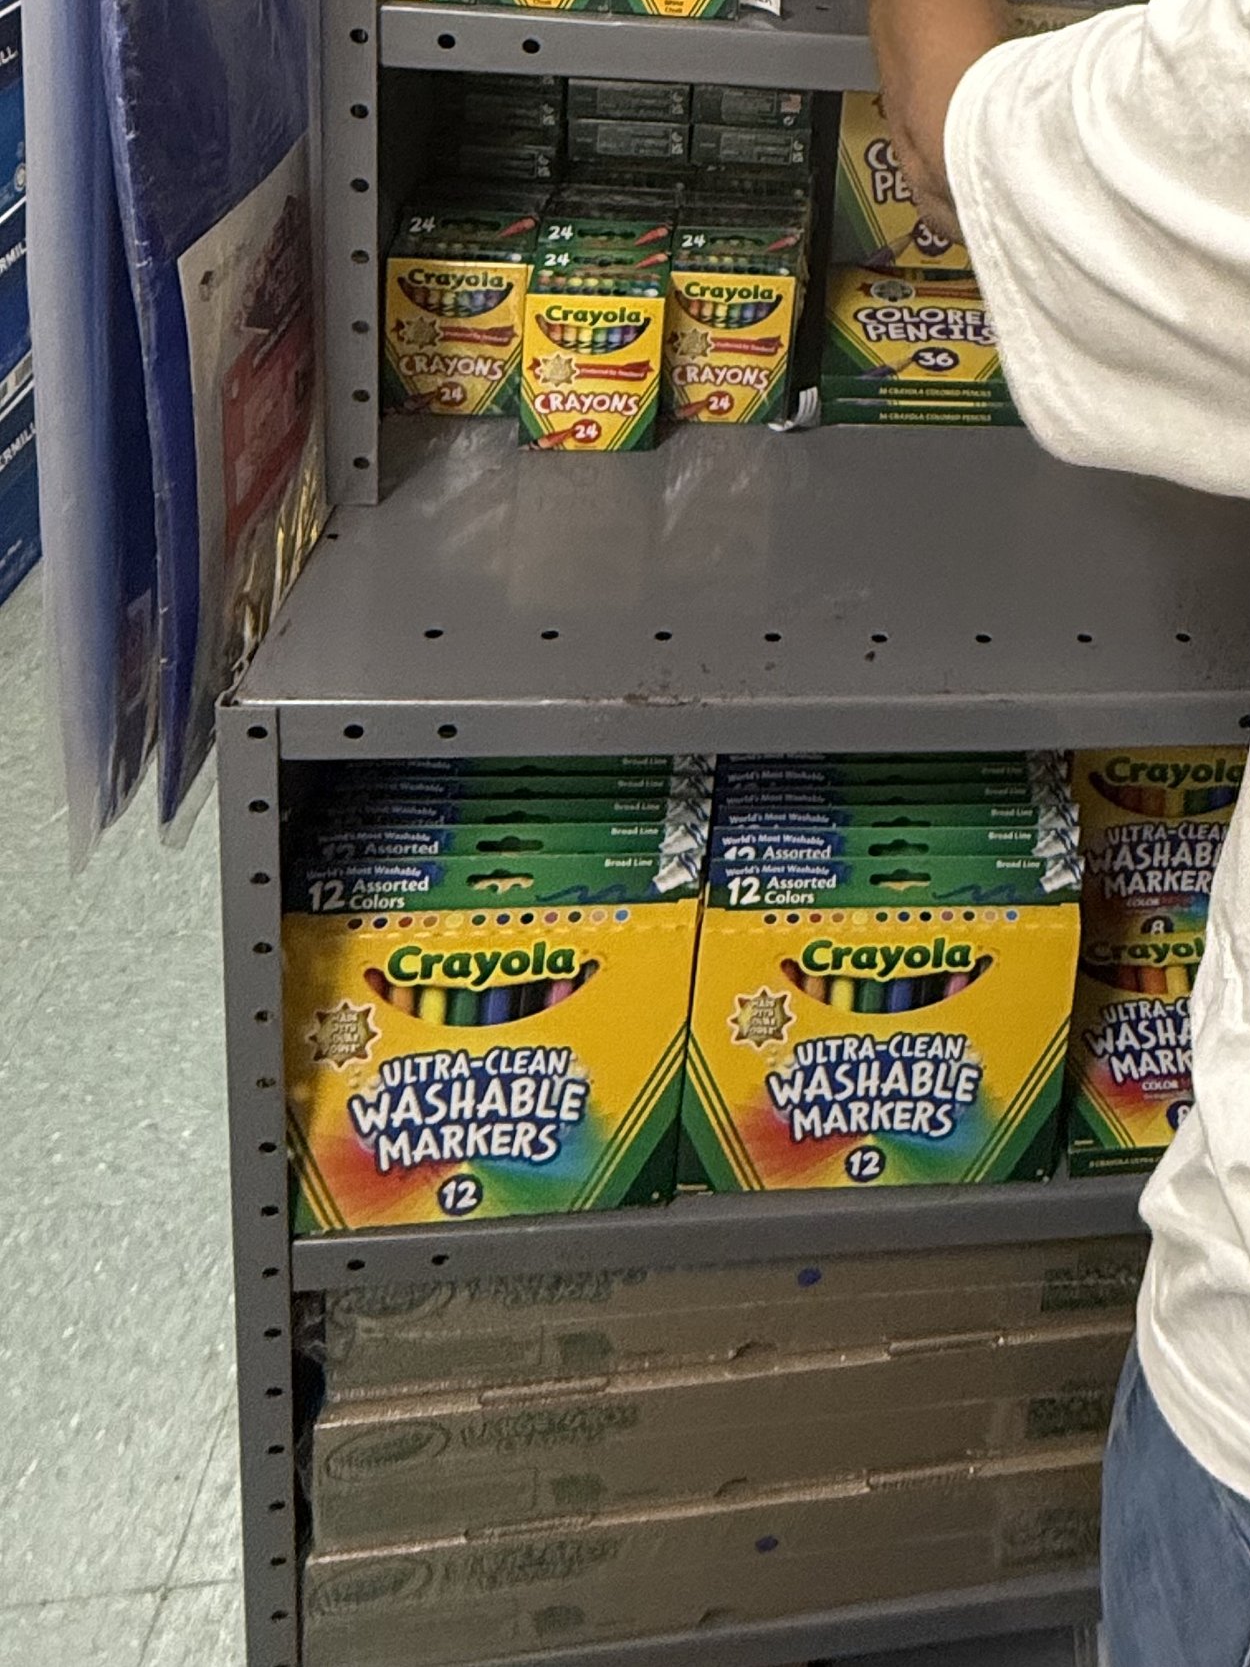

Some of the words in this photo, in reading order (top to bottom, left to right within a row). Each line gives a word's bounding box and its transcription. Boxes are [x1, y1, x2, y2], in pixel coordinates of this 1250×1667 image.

[409, 216, 435, 233] 24
[548, 225, 573, 240] 24
[682, 234, 706, 248] 24
[545, 253, 570, 267] 24
[408, 269, 504, 290] Crayola
[684, 282, 774, 302] Crayola
[545, 305, 641, 326] Crayola
[400, 354, 503, 380] CRAYONS
[918, 351, 954, 367] 36
[673, 366, 770, 390] CRAYONS
[440, 387, 463, 401] 24
[534, 392, 639, 415] CRAYONS
[709, 396, 731, 410] 24
[575, 424, 598, 439] 24
[604, 858, 632, 868] Broad
[634, 857, 653, 867] Line
[787, 865, 829, 875] Washable
[996, 859, 1021, 869] Broad
[1023, 860, 1040, 869] Line
[308, 880, 345, 912] 12
[352, 877, 430, 893] Assorted
[727, 876, 761, 905] 12
[767, 875, 837, 889] Assorted
[1104, 869, 1212, 898] MARKER
[349, 894, 405, 910] Colors
[764, 891, 814, 904] Colors
[801, 937, 973, 977] Crayola
[1088, 937, 1205, 963] Crayol
[387, 940, 575, 986] Crayola
[1085, 1017, 1192, 1054] WASHA
[797, 1036, 966, 1066] ULTRA-CLEAN
[381, 1049, 570, 1087] ULTRA-CLEAN
[1110, 1049, 1193, 1083] MARK
[769, 1061, 979, 1105] WASHABLE
[351, 1078, 586, 1133] WASHABLE
[792, 1102, 952, 1141] MARKERS
[379, 1123, 557, 1171] MARKERS
[850, 1151, 881, 1176] 12
[443, 1181, 477, 1209] 12
